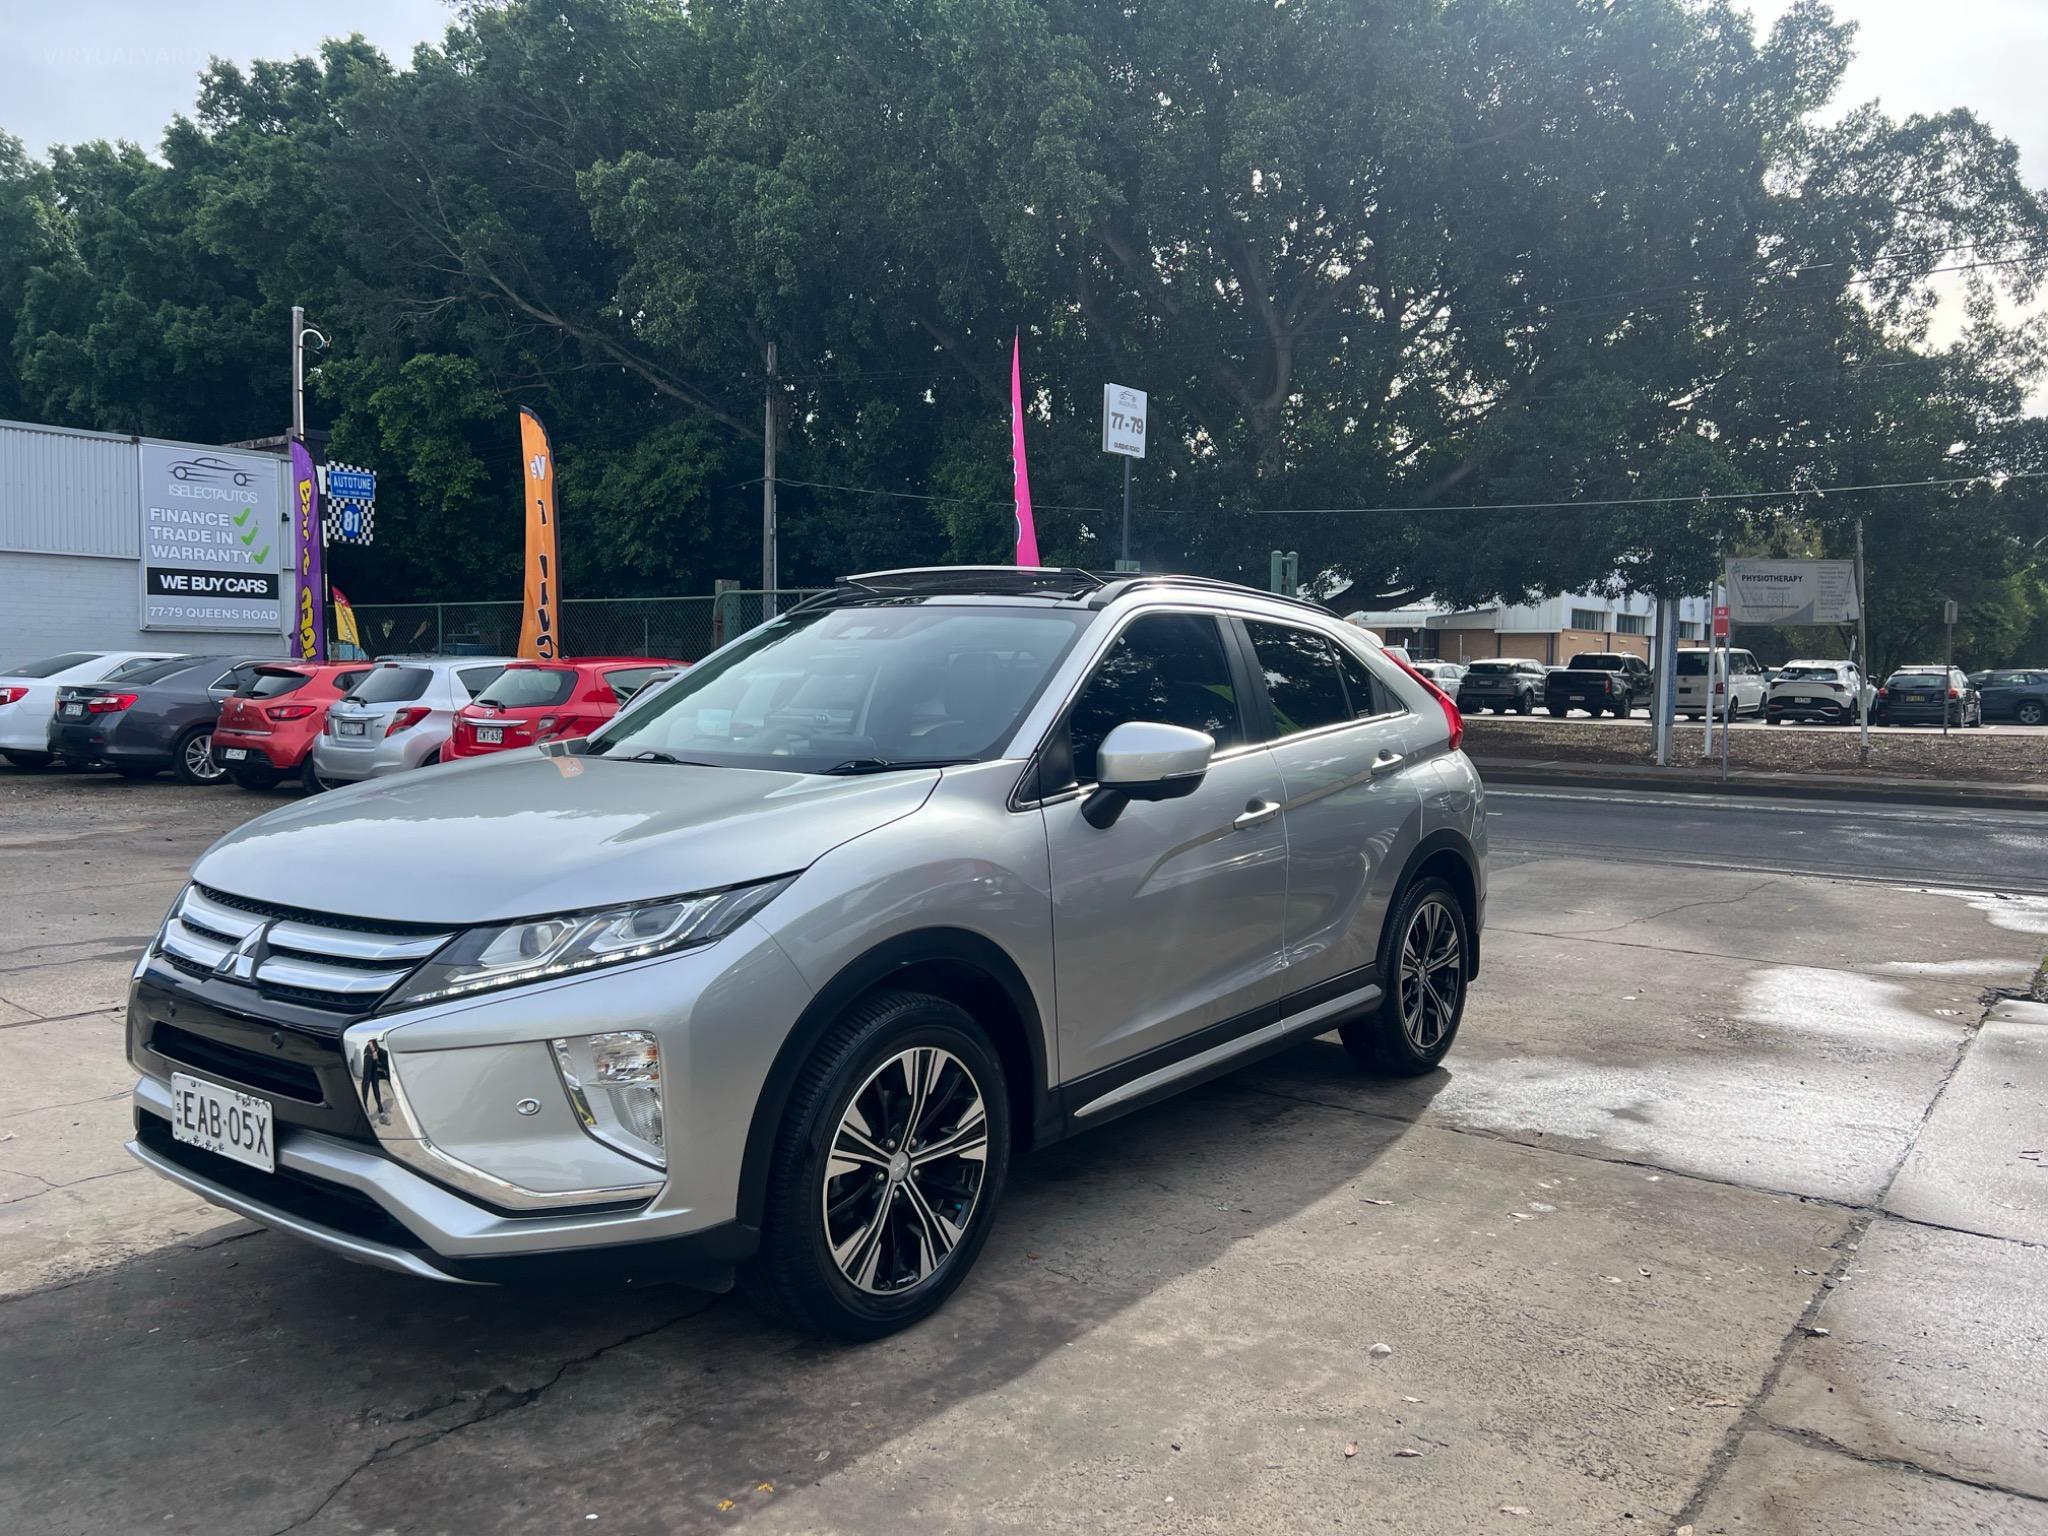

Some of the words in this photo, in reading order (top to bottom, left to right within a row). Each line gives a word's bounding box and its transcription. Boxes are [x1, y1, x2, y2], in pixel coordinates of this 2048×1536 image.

[333, 475, 371, 490] AUTOTUNE
[149, 507, 230, 527] FINANCE
[343, 510, 360, 533] 81
[149, 526, 212, 543] TRADE
[216, 530, 234, 545] IN
[151, 544, 253, 563] WARRANTY
[160, 574, 189, 590] WE
[192, 576, 225, 592] BUY
[225, 577, 268, 594] CARS
[1741, 574, 1803, 583] PHYSIOTHERAPY
[149, 606, 183, 618] 77-79
[186, 607, 240, 619] QUEENS
[242, 609, 278, 620] ROAD
